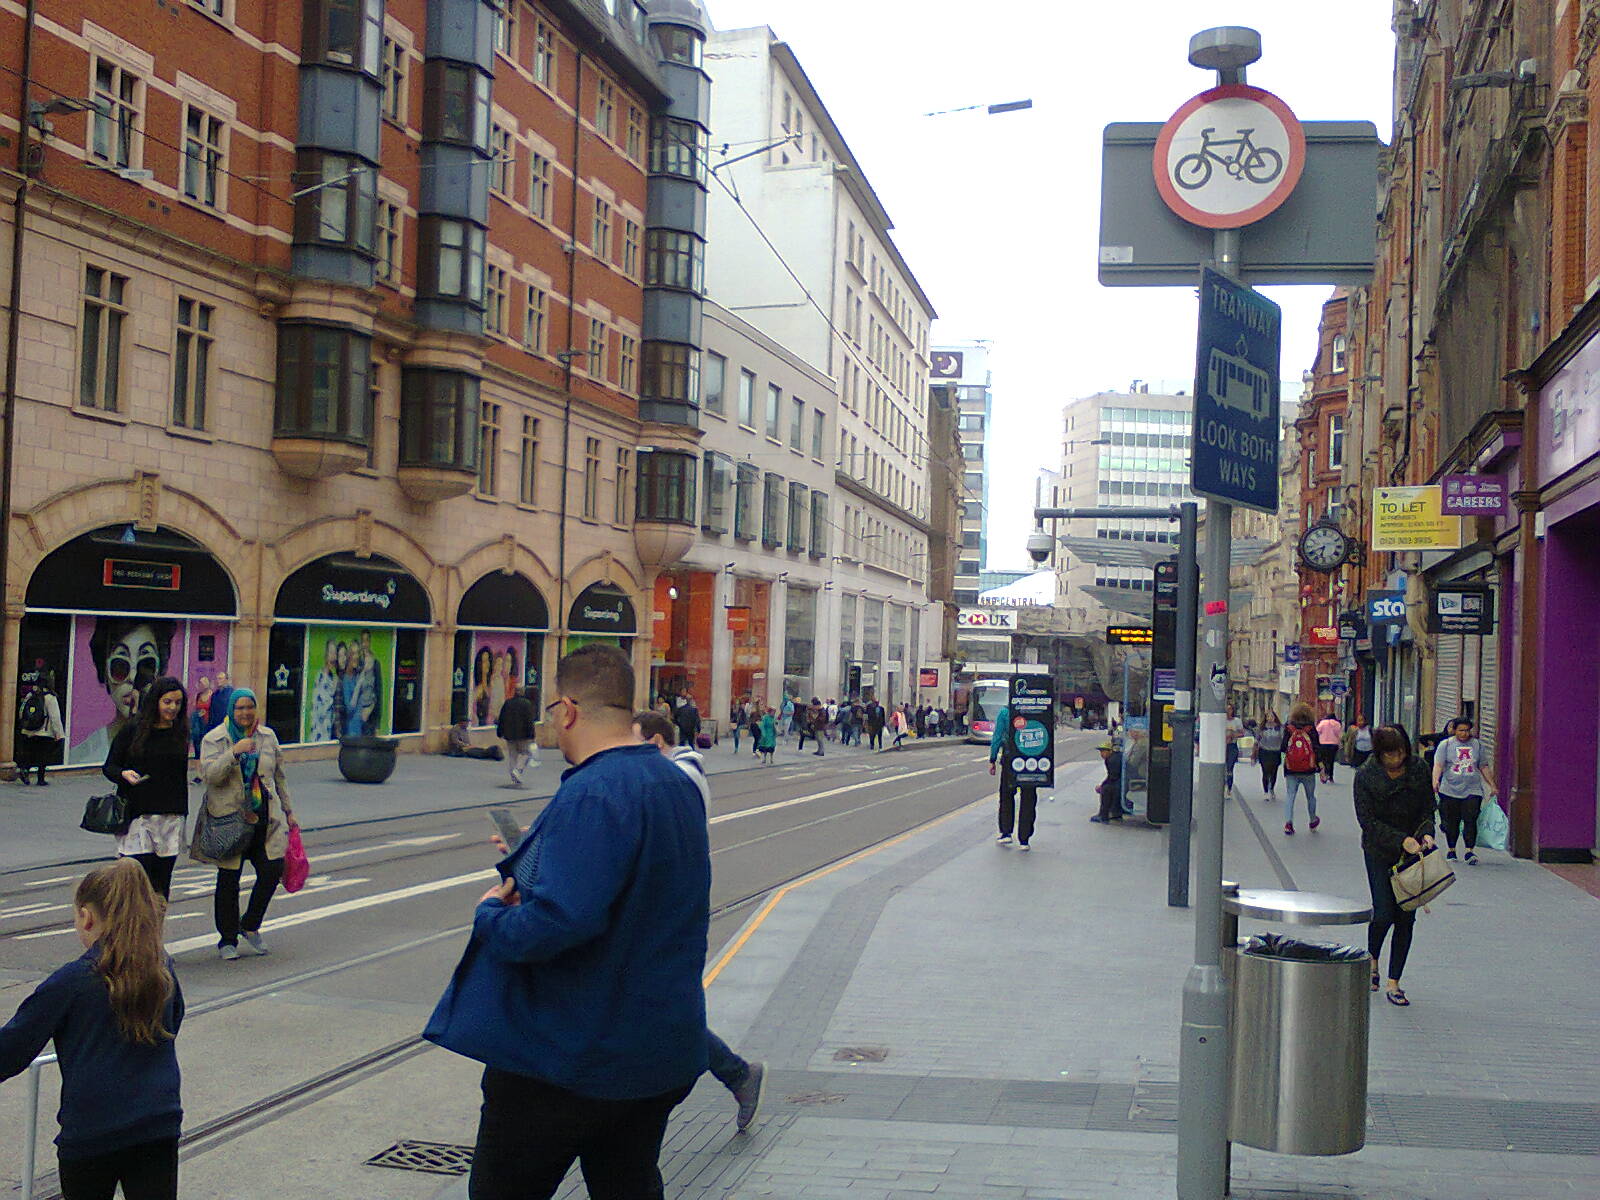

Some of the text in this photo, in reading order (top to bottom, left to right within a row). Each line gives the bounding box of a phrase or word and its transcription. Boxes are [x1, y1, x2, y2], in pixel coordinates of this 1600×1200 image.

[1213, 284, 1273, 338] TRAMWAY
[1200, 418, 1274, 465] LOOK BOTH
[1219, 457, 1256, 492] WAYS
[1380, 501, 1427, 514] TO LET
[1447, 496, 1502, 508] CAREERS
[321, 583, 391, 609] Superdrug
[1001, 596, 1038, 607] CENTRAL
[989, 613, 1011, 626] UK
